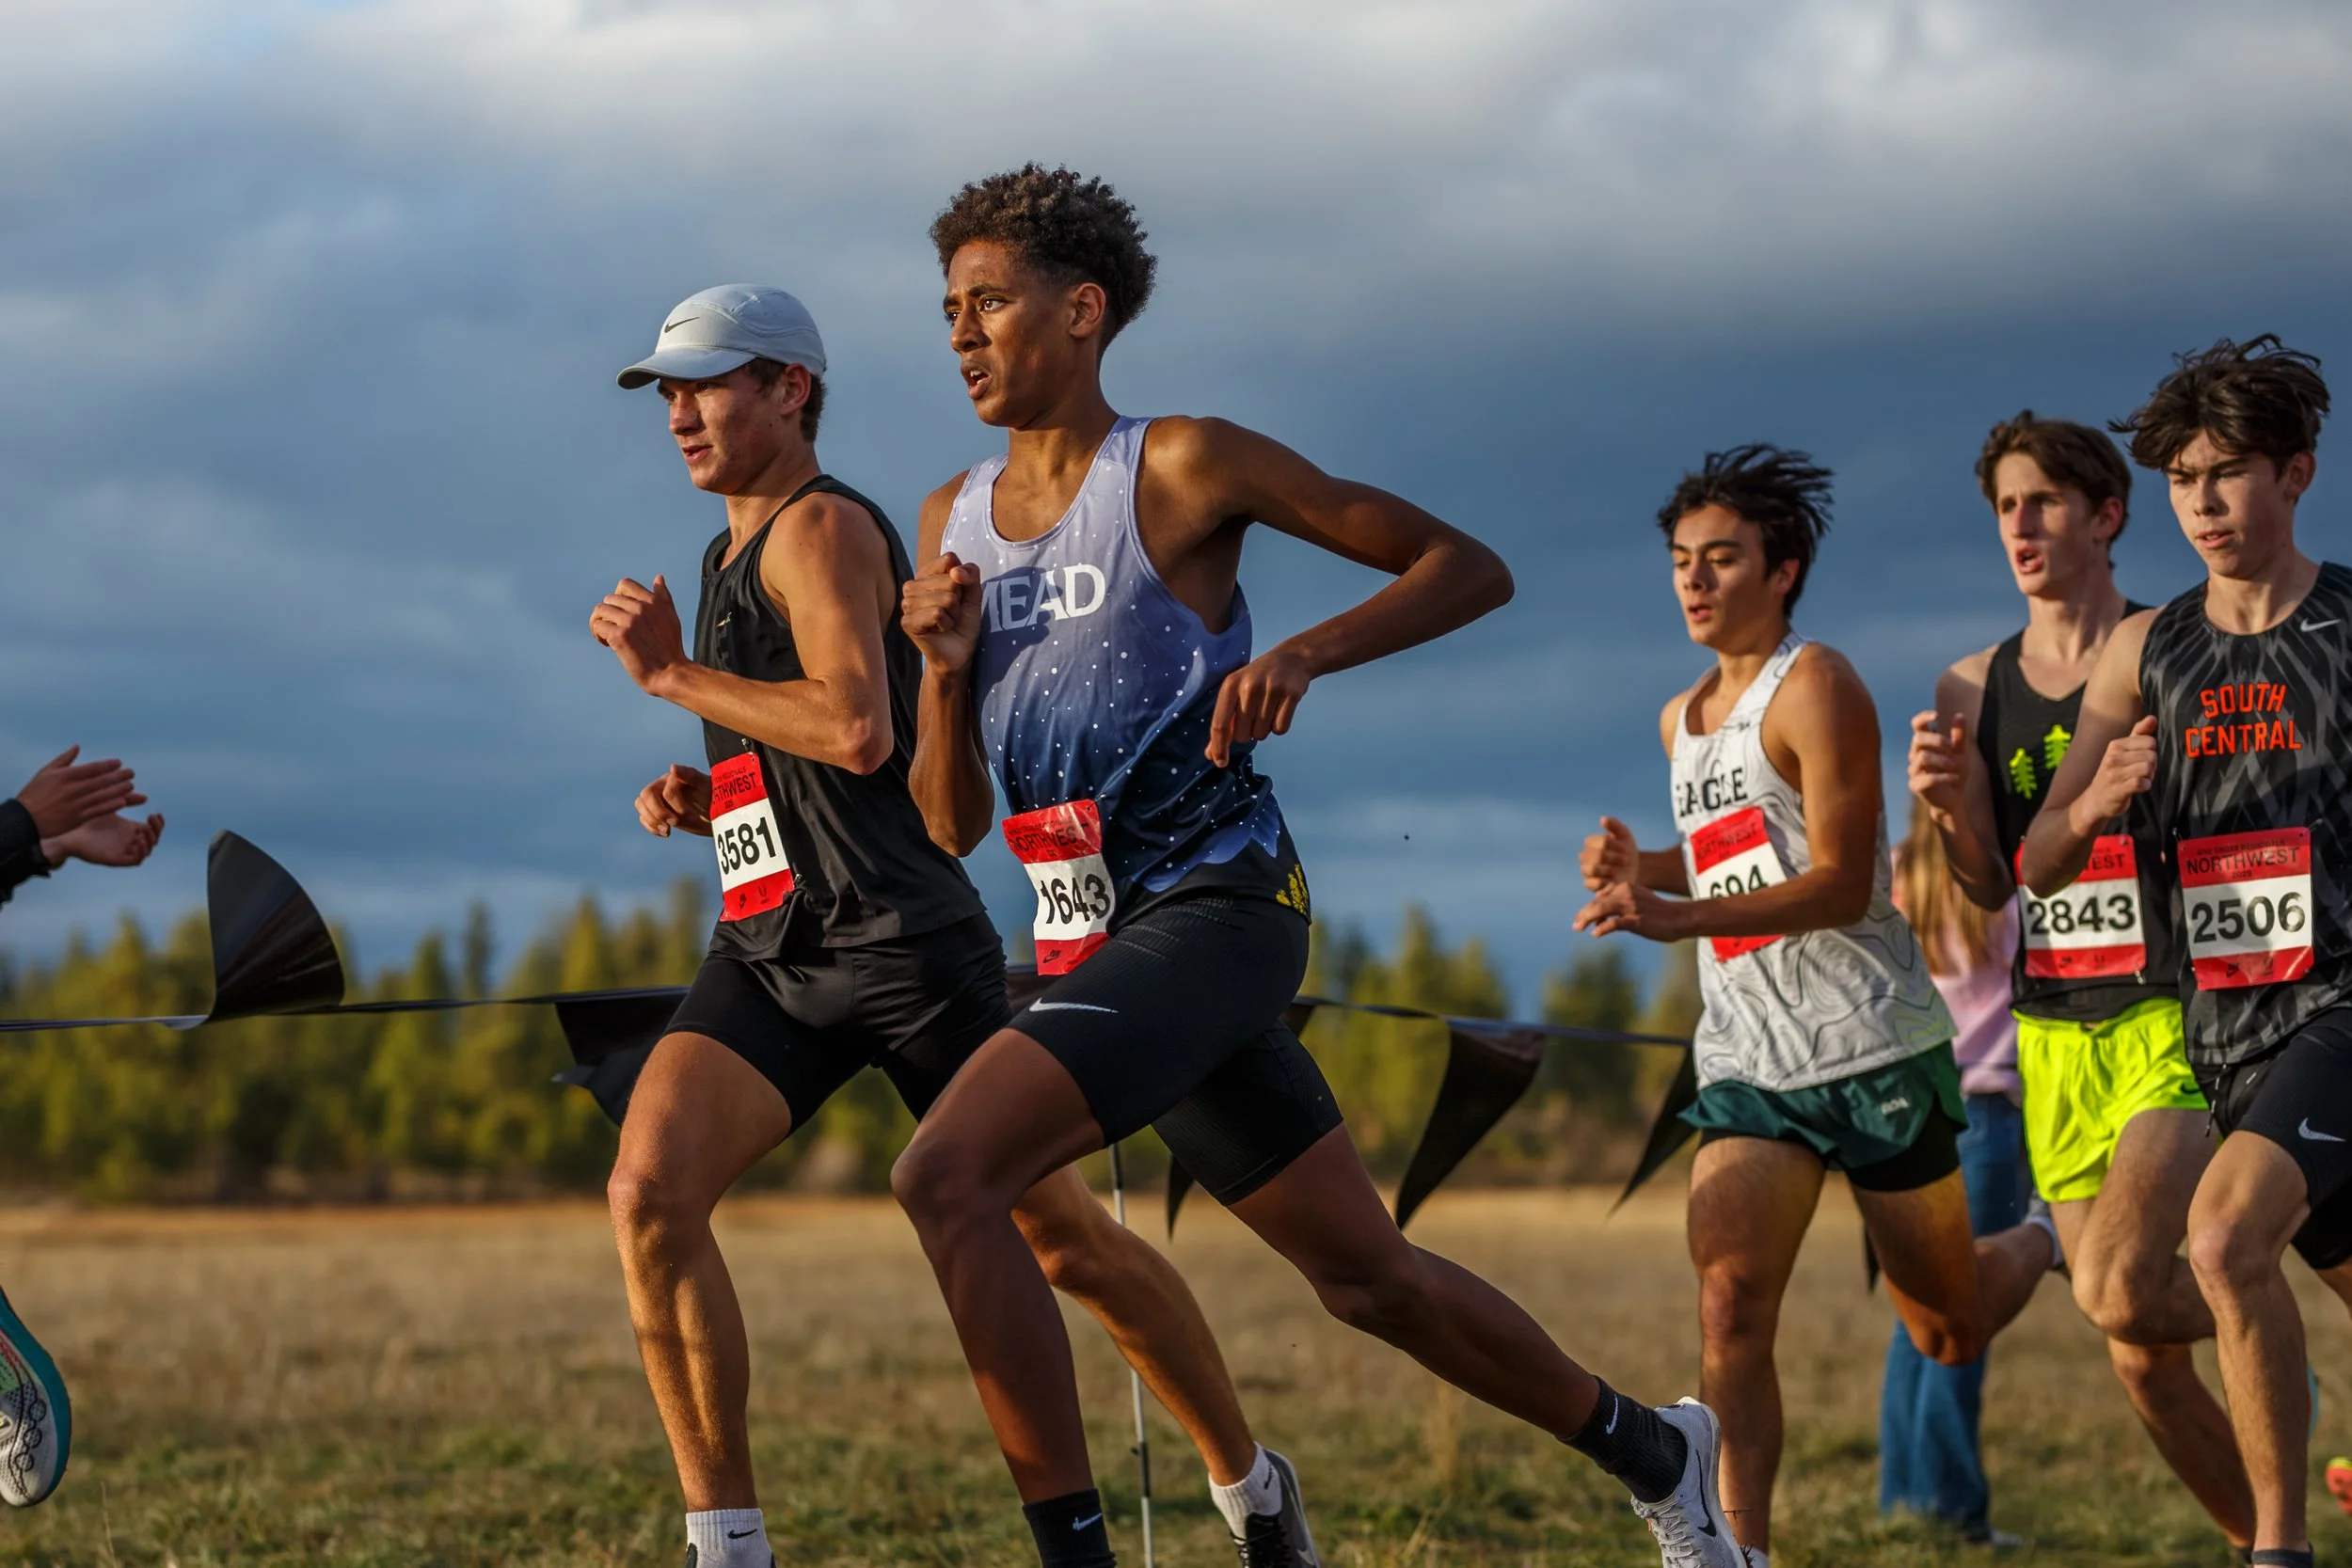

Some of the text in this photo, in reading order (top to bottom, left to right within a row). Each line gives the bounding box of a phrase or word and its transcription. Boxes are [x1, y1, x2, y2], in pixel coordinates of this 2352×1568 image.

[2200, 681, 2287, 719] SOUTH
[2185, 719, 2302, 759] CENTRAL
[713, 771, 756, 803] RTHWEST
[717, 816, 777, 875] 3581
[2186, 847, 2299, 875] NORTHWEST
[1040, 874, 1111, 925] 1643
[2026, 893, 2137, 936] 2843
[2191, 891, 2306, 943] 2506
